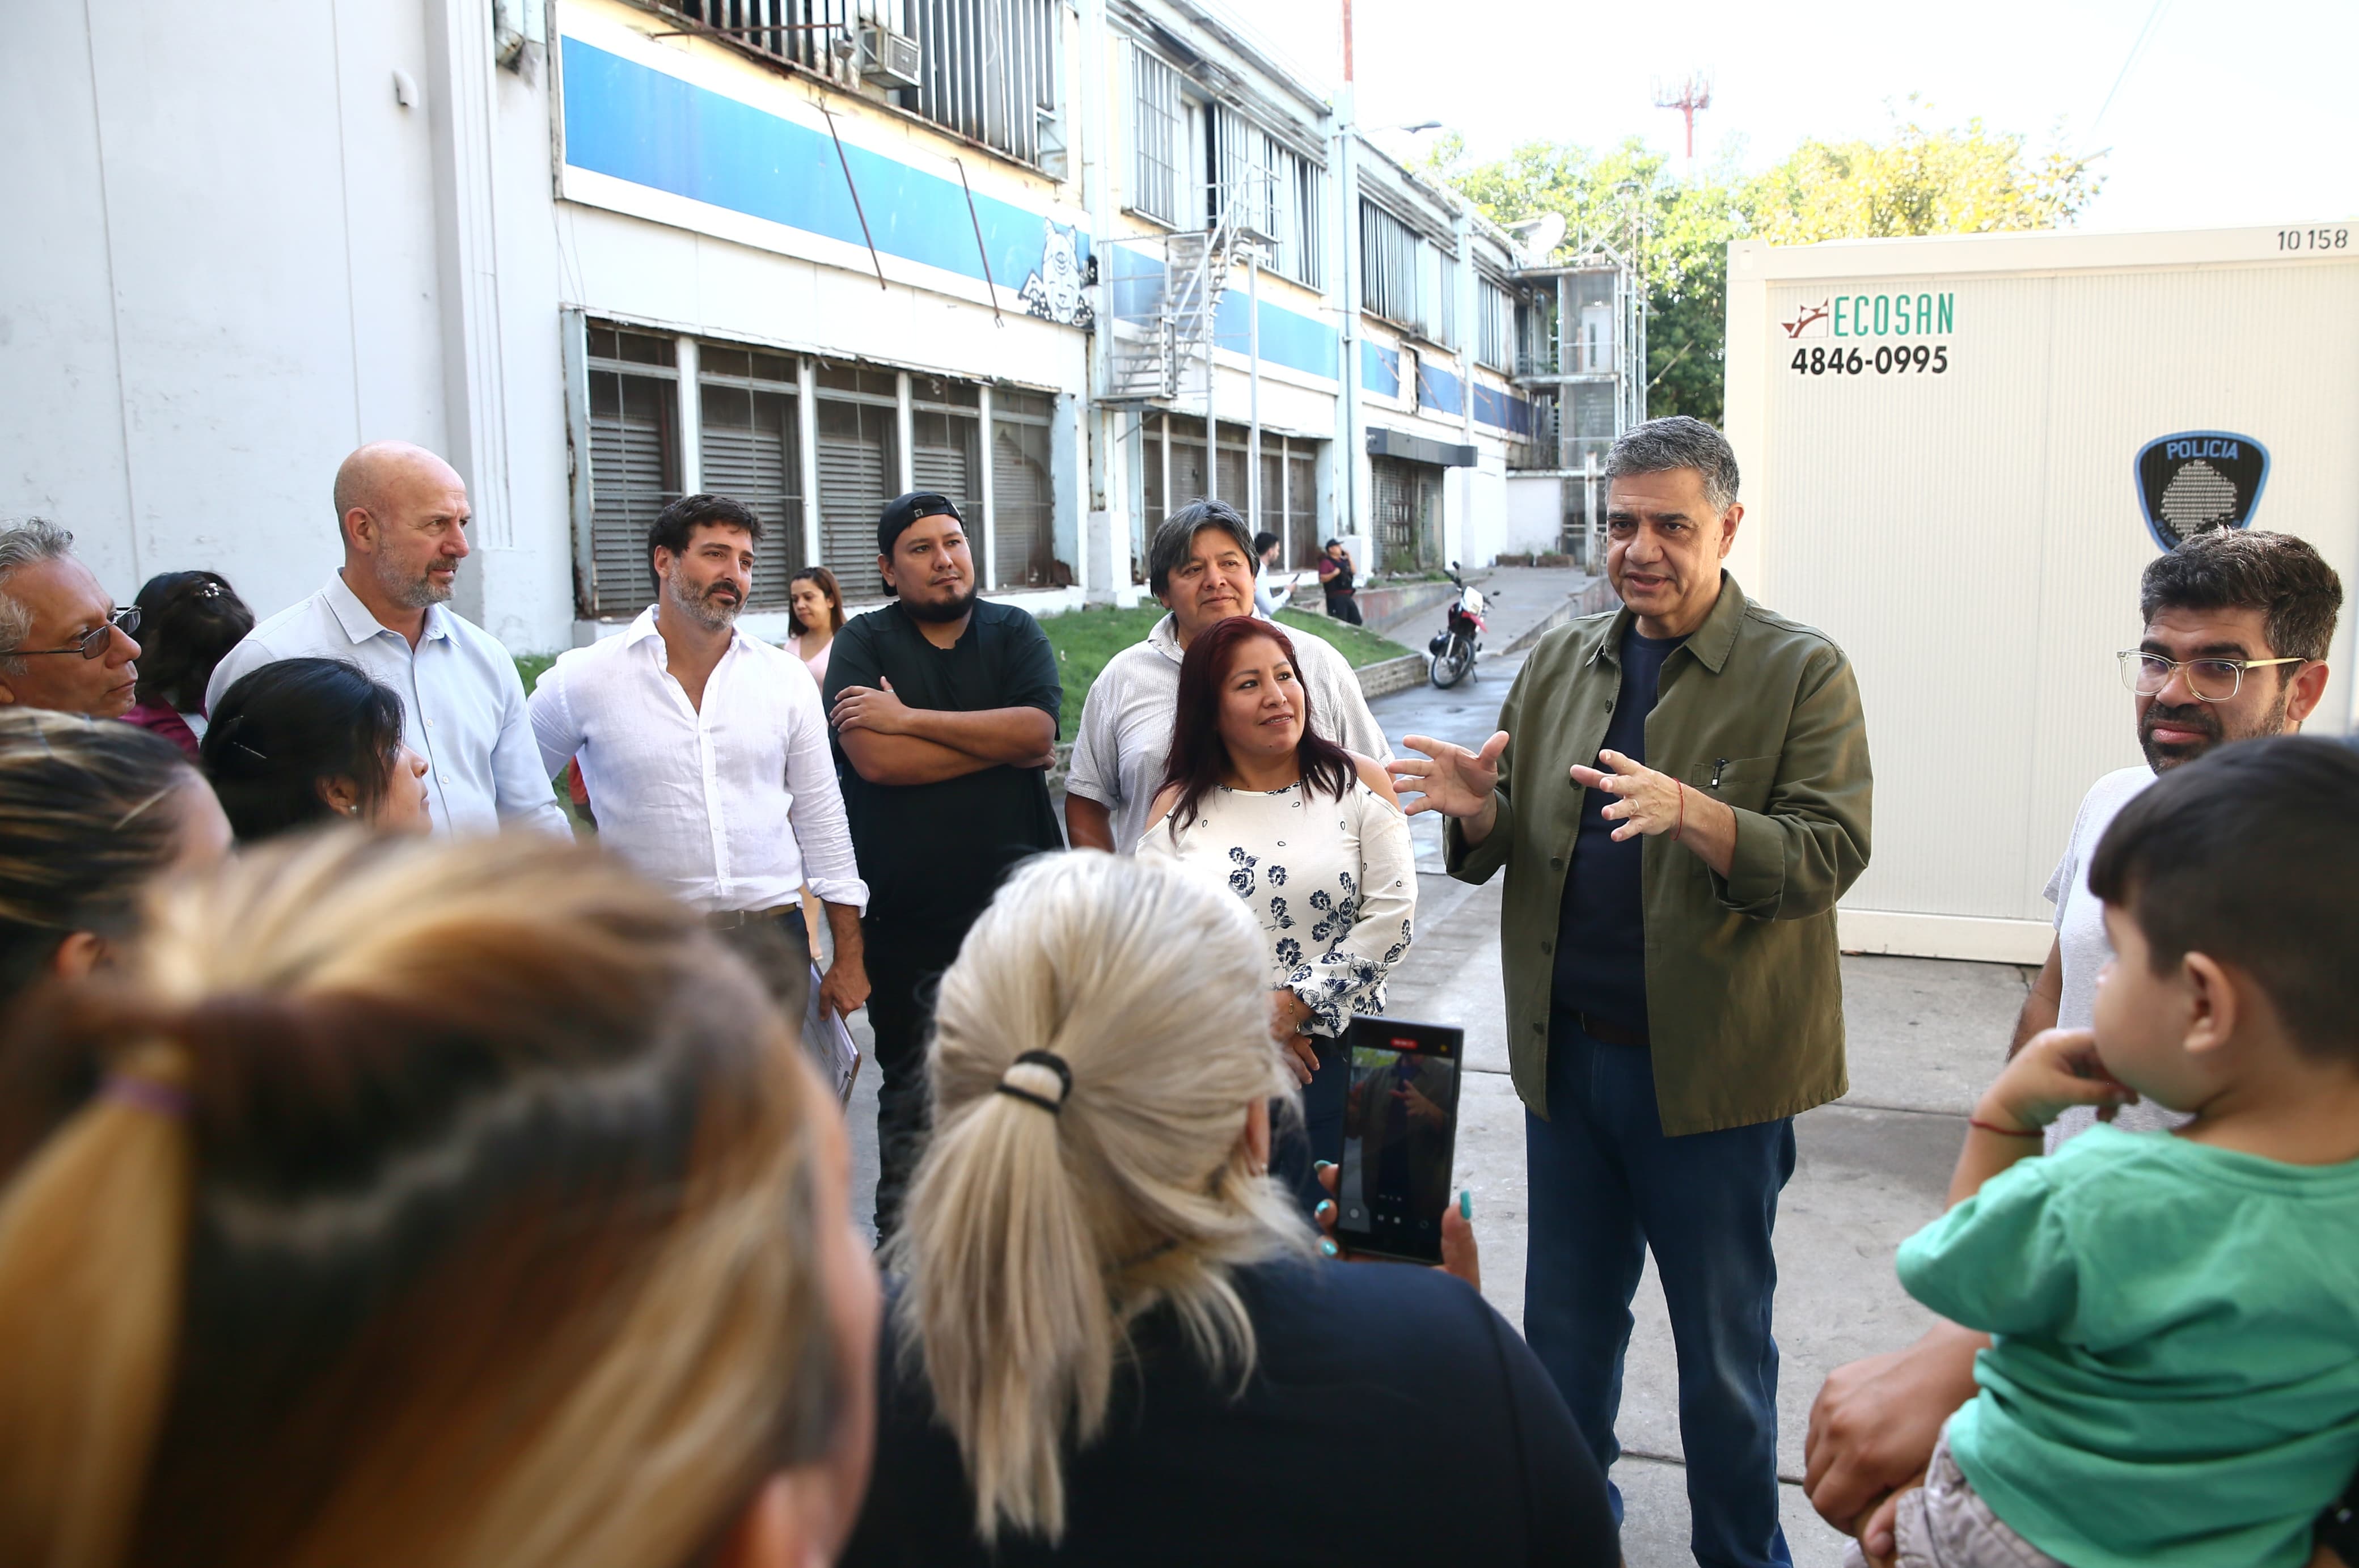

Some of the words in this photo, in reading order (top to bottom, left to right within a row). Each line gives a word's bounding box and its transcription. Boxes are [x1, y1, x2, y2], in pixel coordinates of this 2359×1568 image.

[1834, 293, 1954, 337] ECOSAN
[1791, 345, 1948, 375] 4846-0995
[2166, 439, 2239, 460] POLICIA
